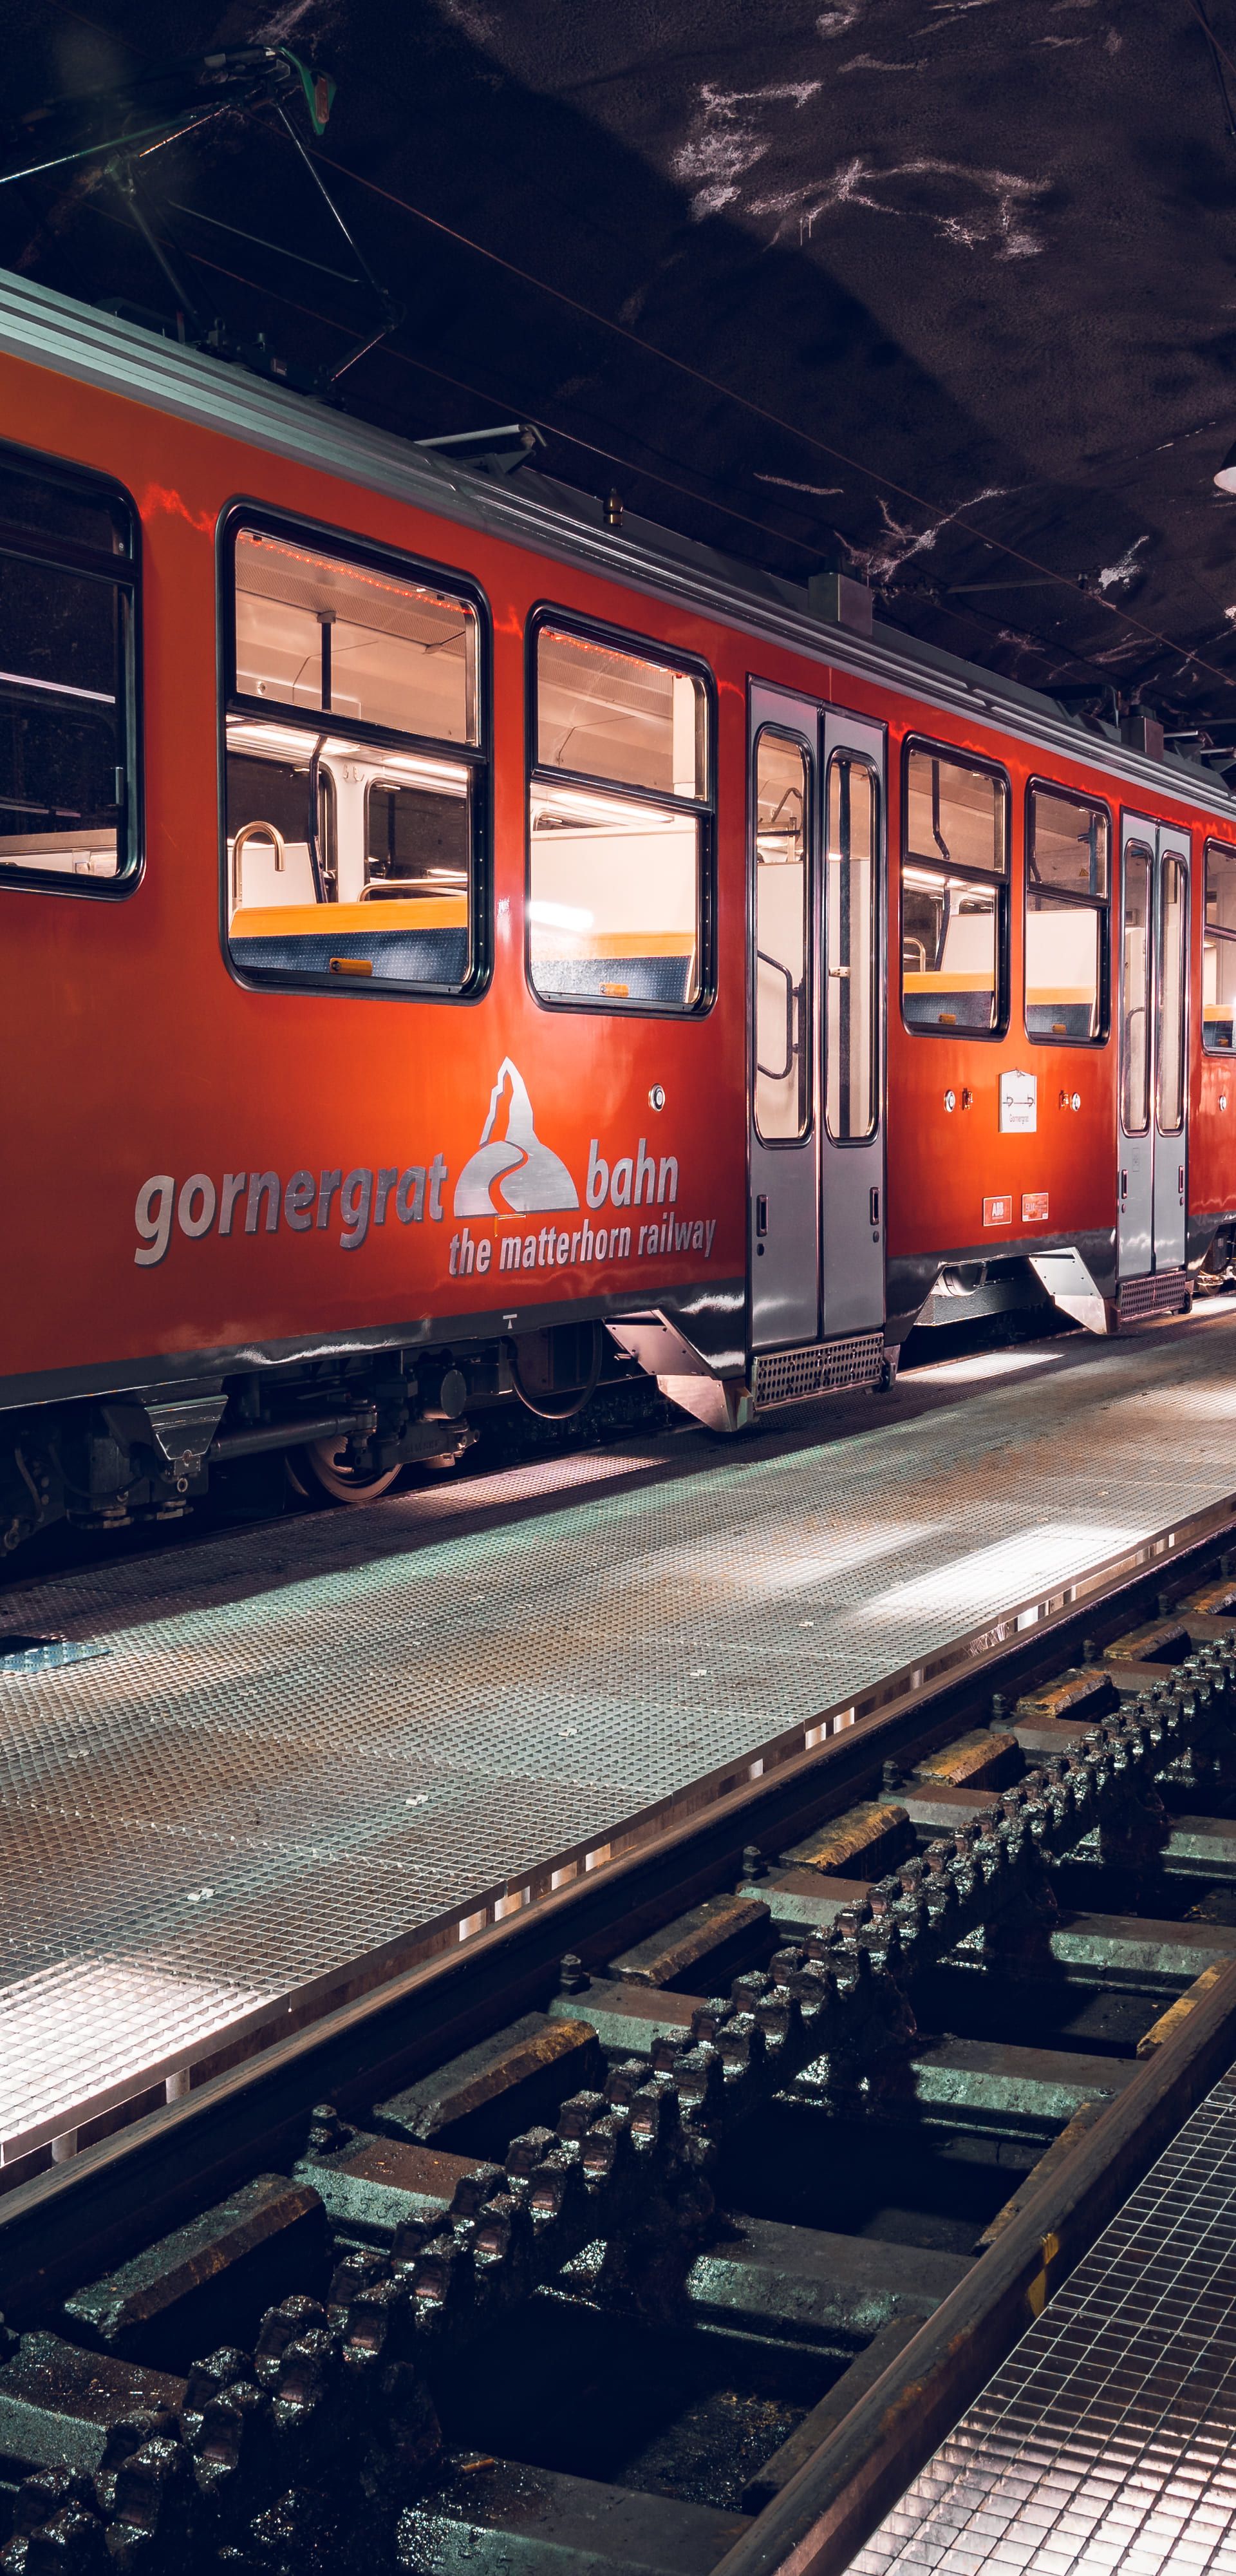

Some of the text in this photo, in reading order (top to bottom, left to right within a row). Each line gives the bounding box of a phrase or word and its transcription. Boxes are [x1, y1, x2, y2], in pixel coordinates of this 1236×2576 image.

[134, 1137, 679, 1266] gornergrat bahn
[991, 1202, 1004, 1217] ABB
[449, 1211, 716, 1275] the matterhorn railway
